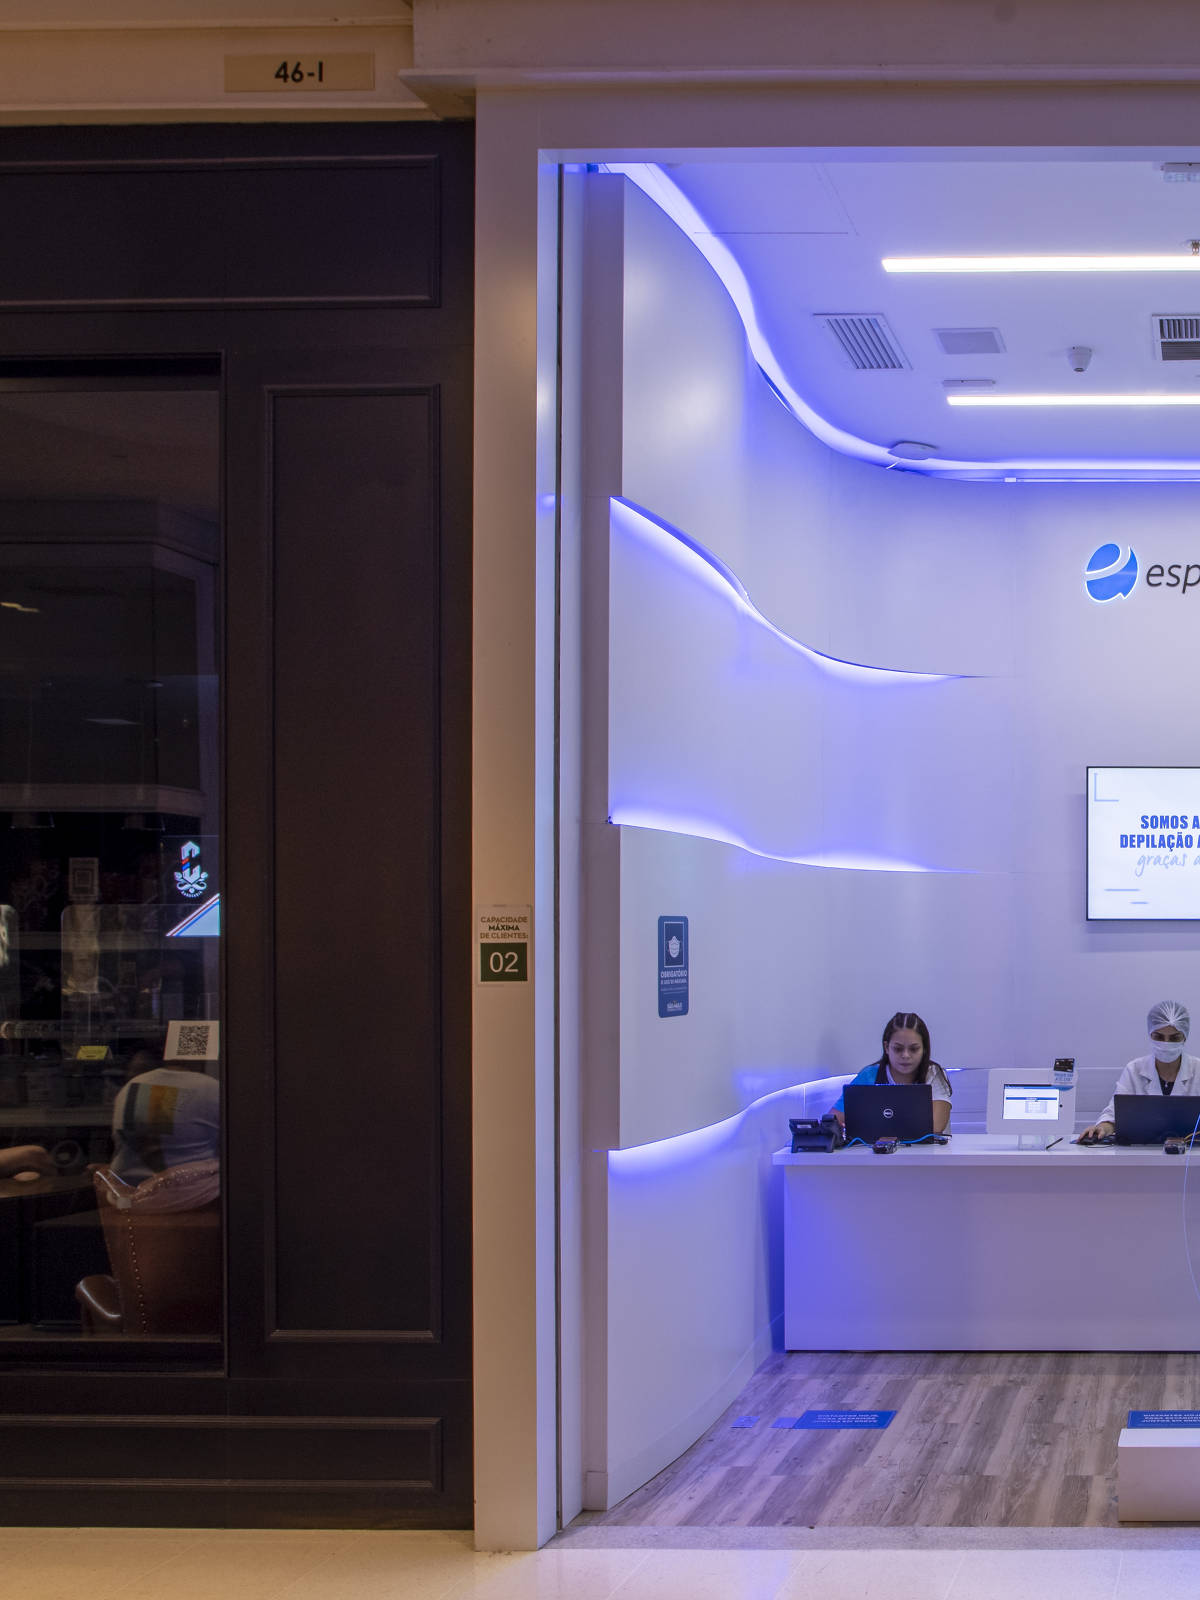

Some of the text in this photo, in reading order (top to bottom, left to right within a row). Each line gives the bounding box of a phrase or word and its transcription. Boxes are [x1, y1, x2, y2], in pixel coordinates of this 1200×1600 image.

[274, 60, 324, 83] 46-I
[1140, 815, 1188, 830] SOMOS
[1192, 815, 1200, 829] A
[1119, 832, 1194, 851] DEPILAÇÃO
[1135, 851, 1187, 877] graças
[488, 923, 520, 931] MÁXIMA
[489, 951, 519, 973] 02
